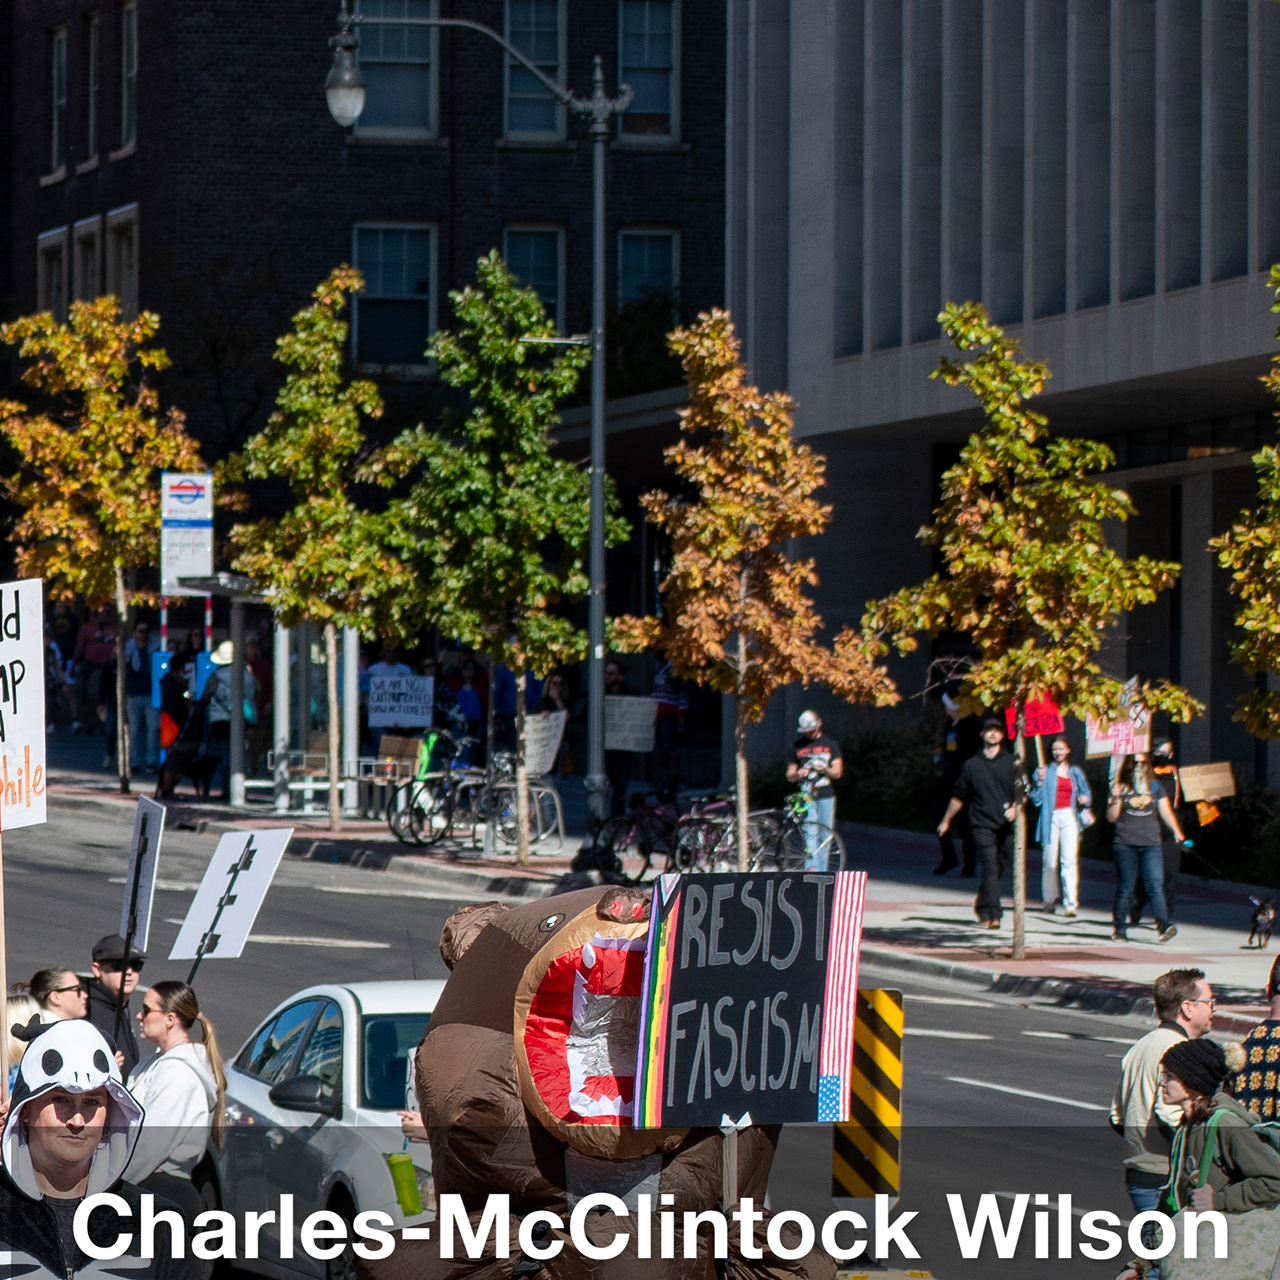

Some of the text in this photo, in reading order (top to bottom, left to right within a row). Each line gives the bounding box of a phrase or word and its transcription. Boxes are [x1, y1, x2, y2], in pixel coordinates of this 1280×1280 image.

[372, 679, 427, 693] WE ARE NOT
[371, 692, 431, 704] OUTNUMBERED
[388, 705, 402, 714] ACT
[1008, 714, 1062, 735] AERICA
[680, 874, 834, 970] RESIST
[667, 991, 820, 1107] FASCISM
